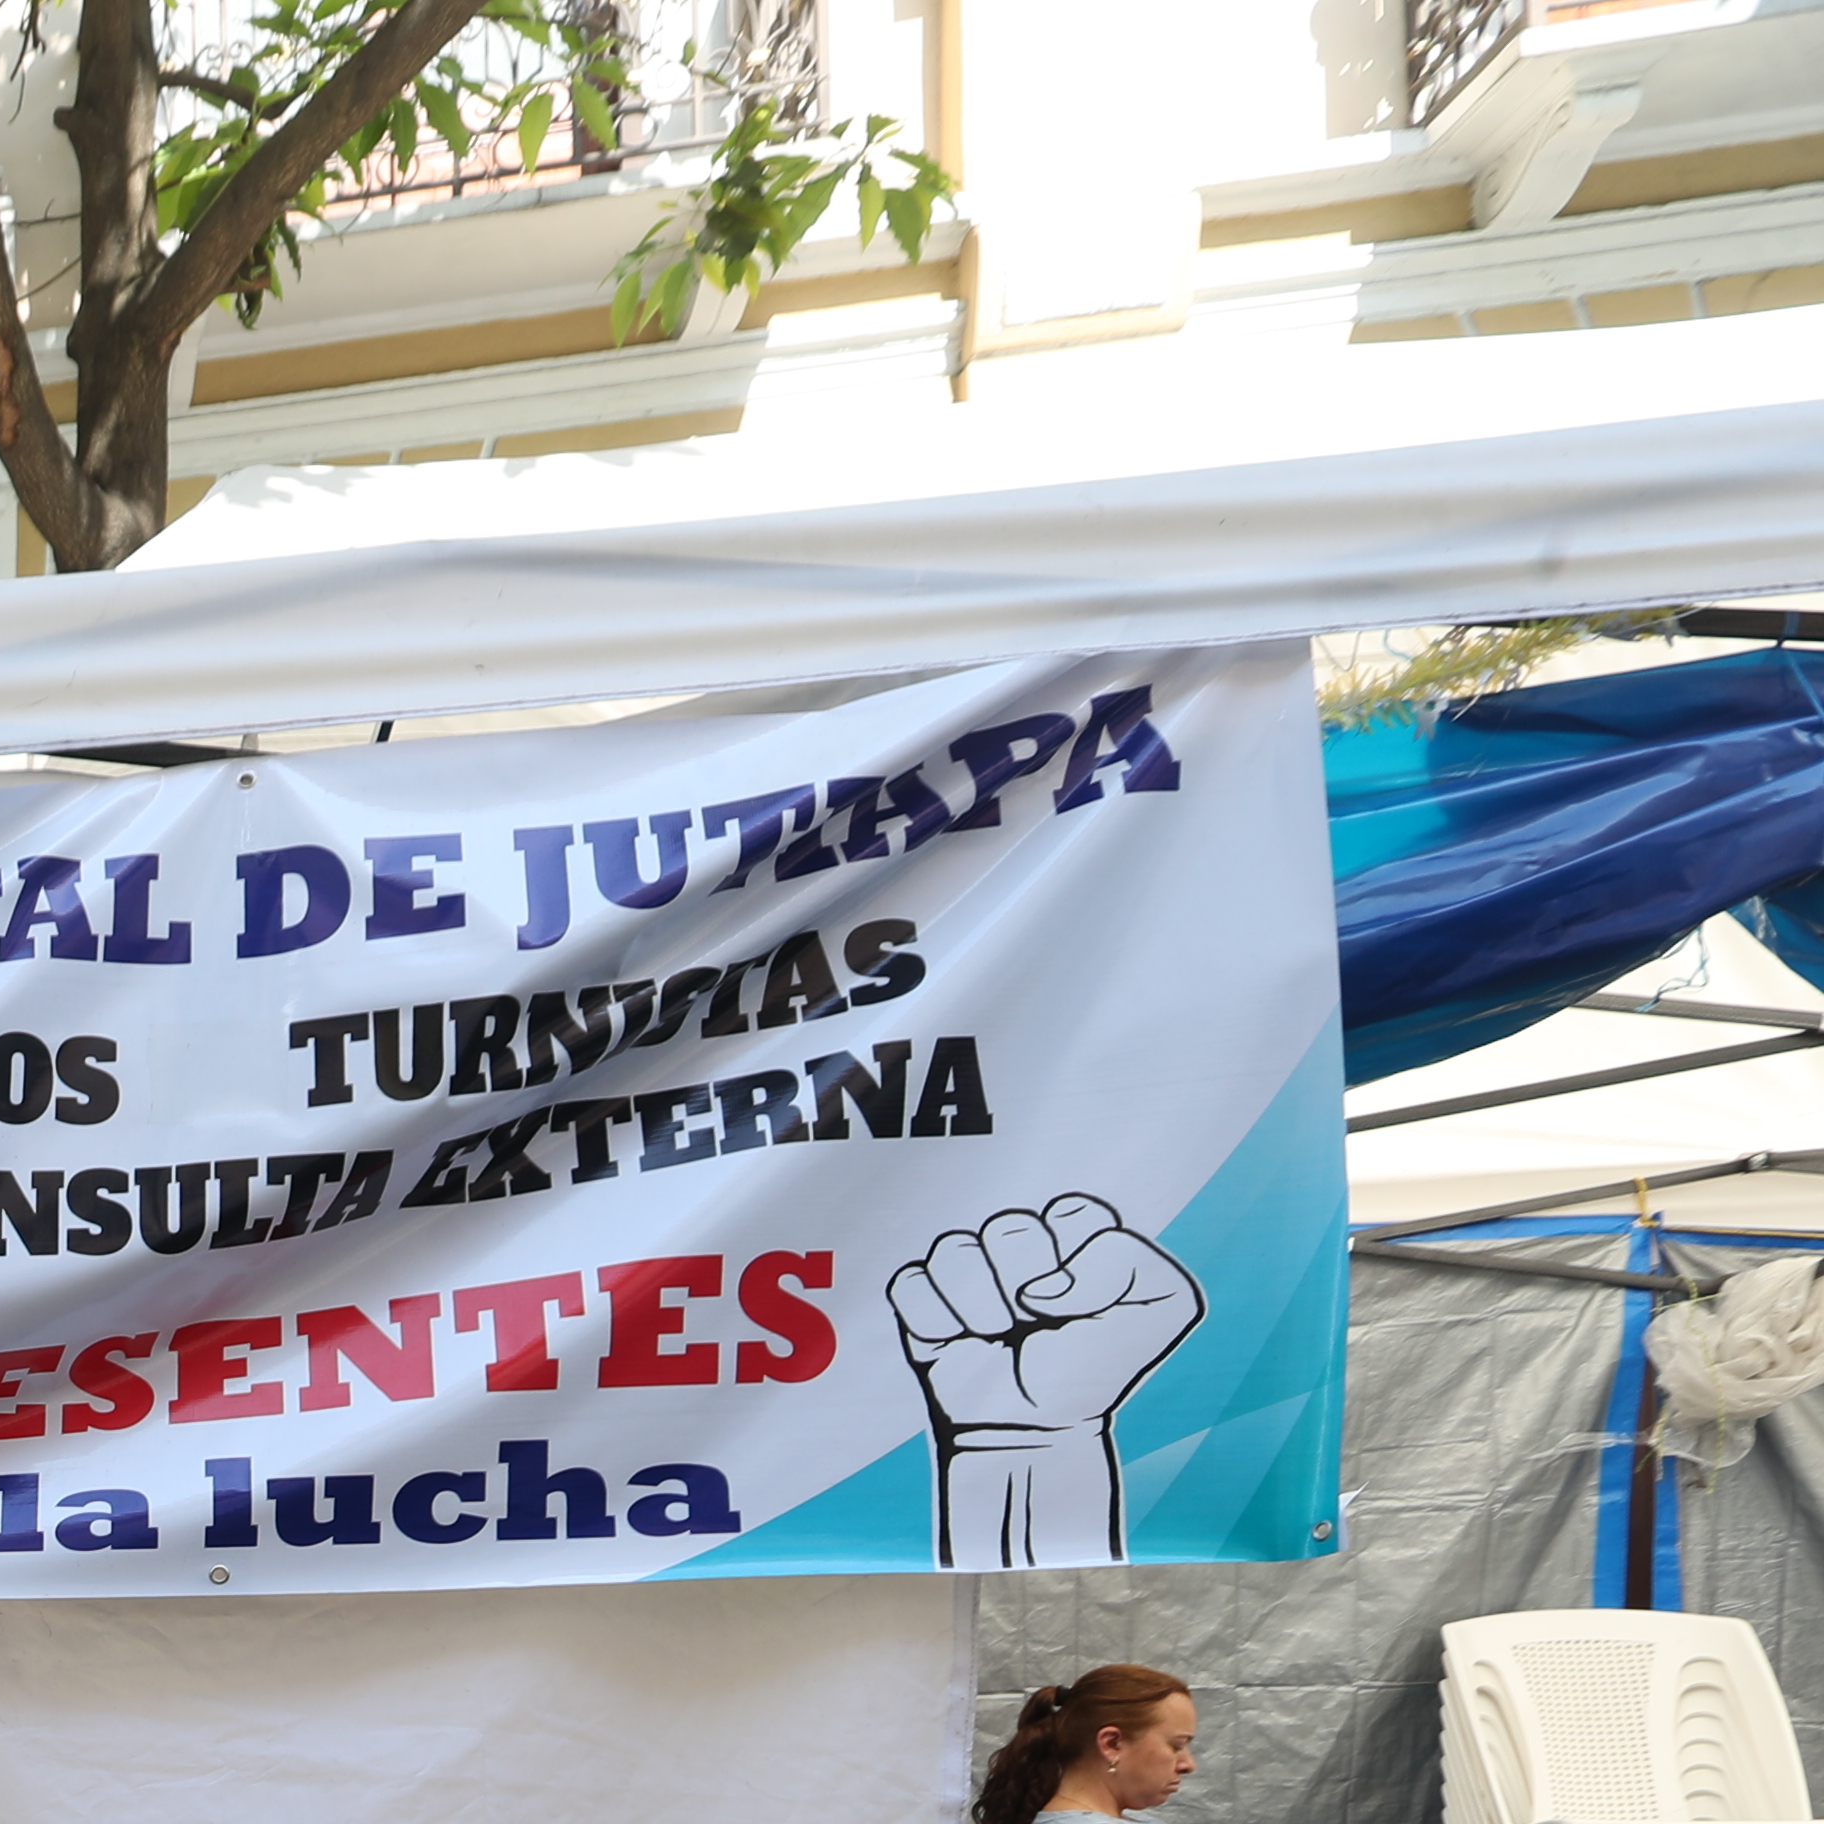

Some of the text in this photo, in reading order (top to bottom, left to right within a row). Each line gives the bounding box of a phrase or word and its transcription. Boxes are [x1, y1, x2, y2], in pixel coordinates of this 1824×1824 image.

[236, 837, 466, 957] DE
[399, 1035, 995, 1215] EXTERNA
[202, 1441, 739, 1548] lucha
